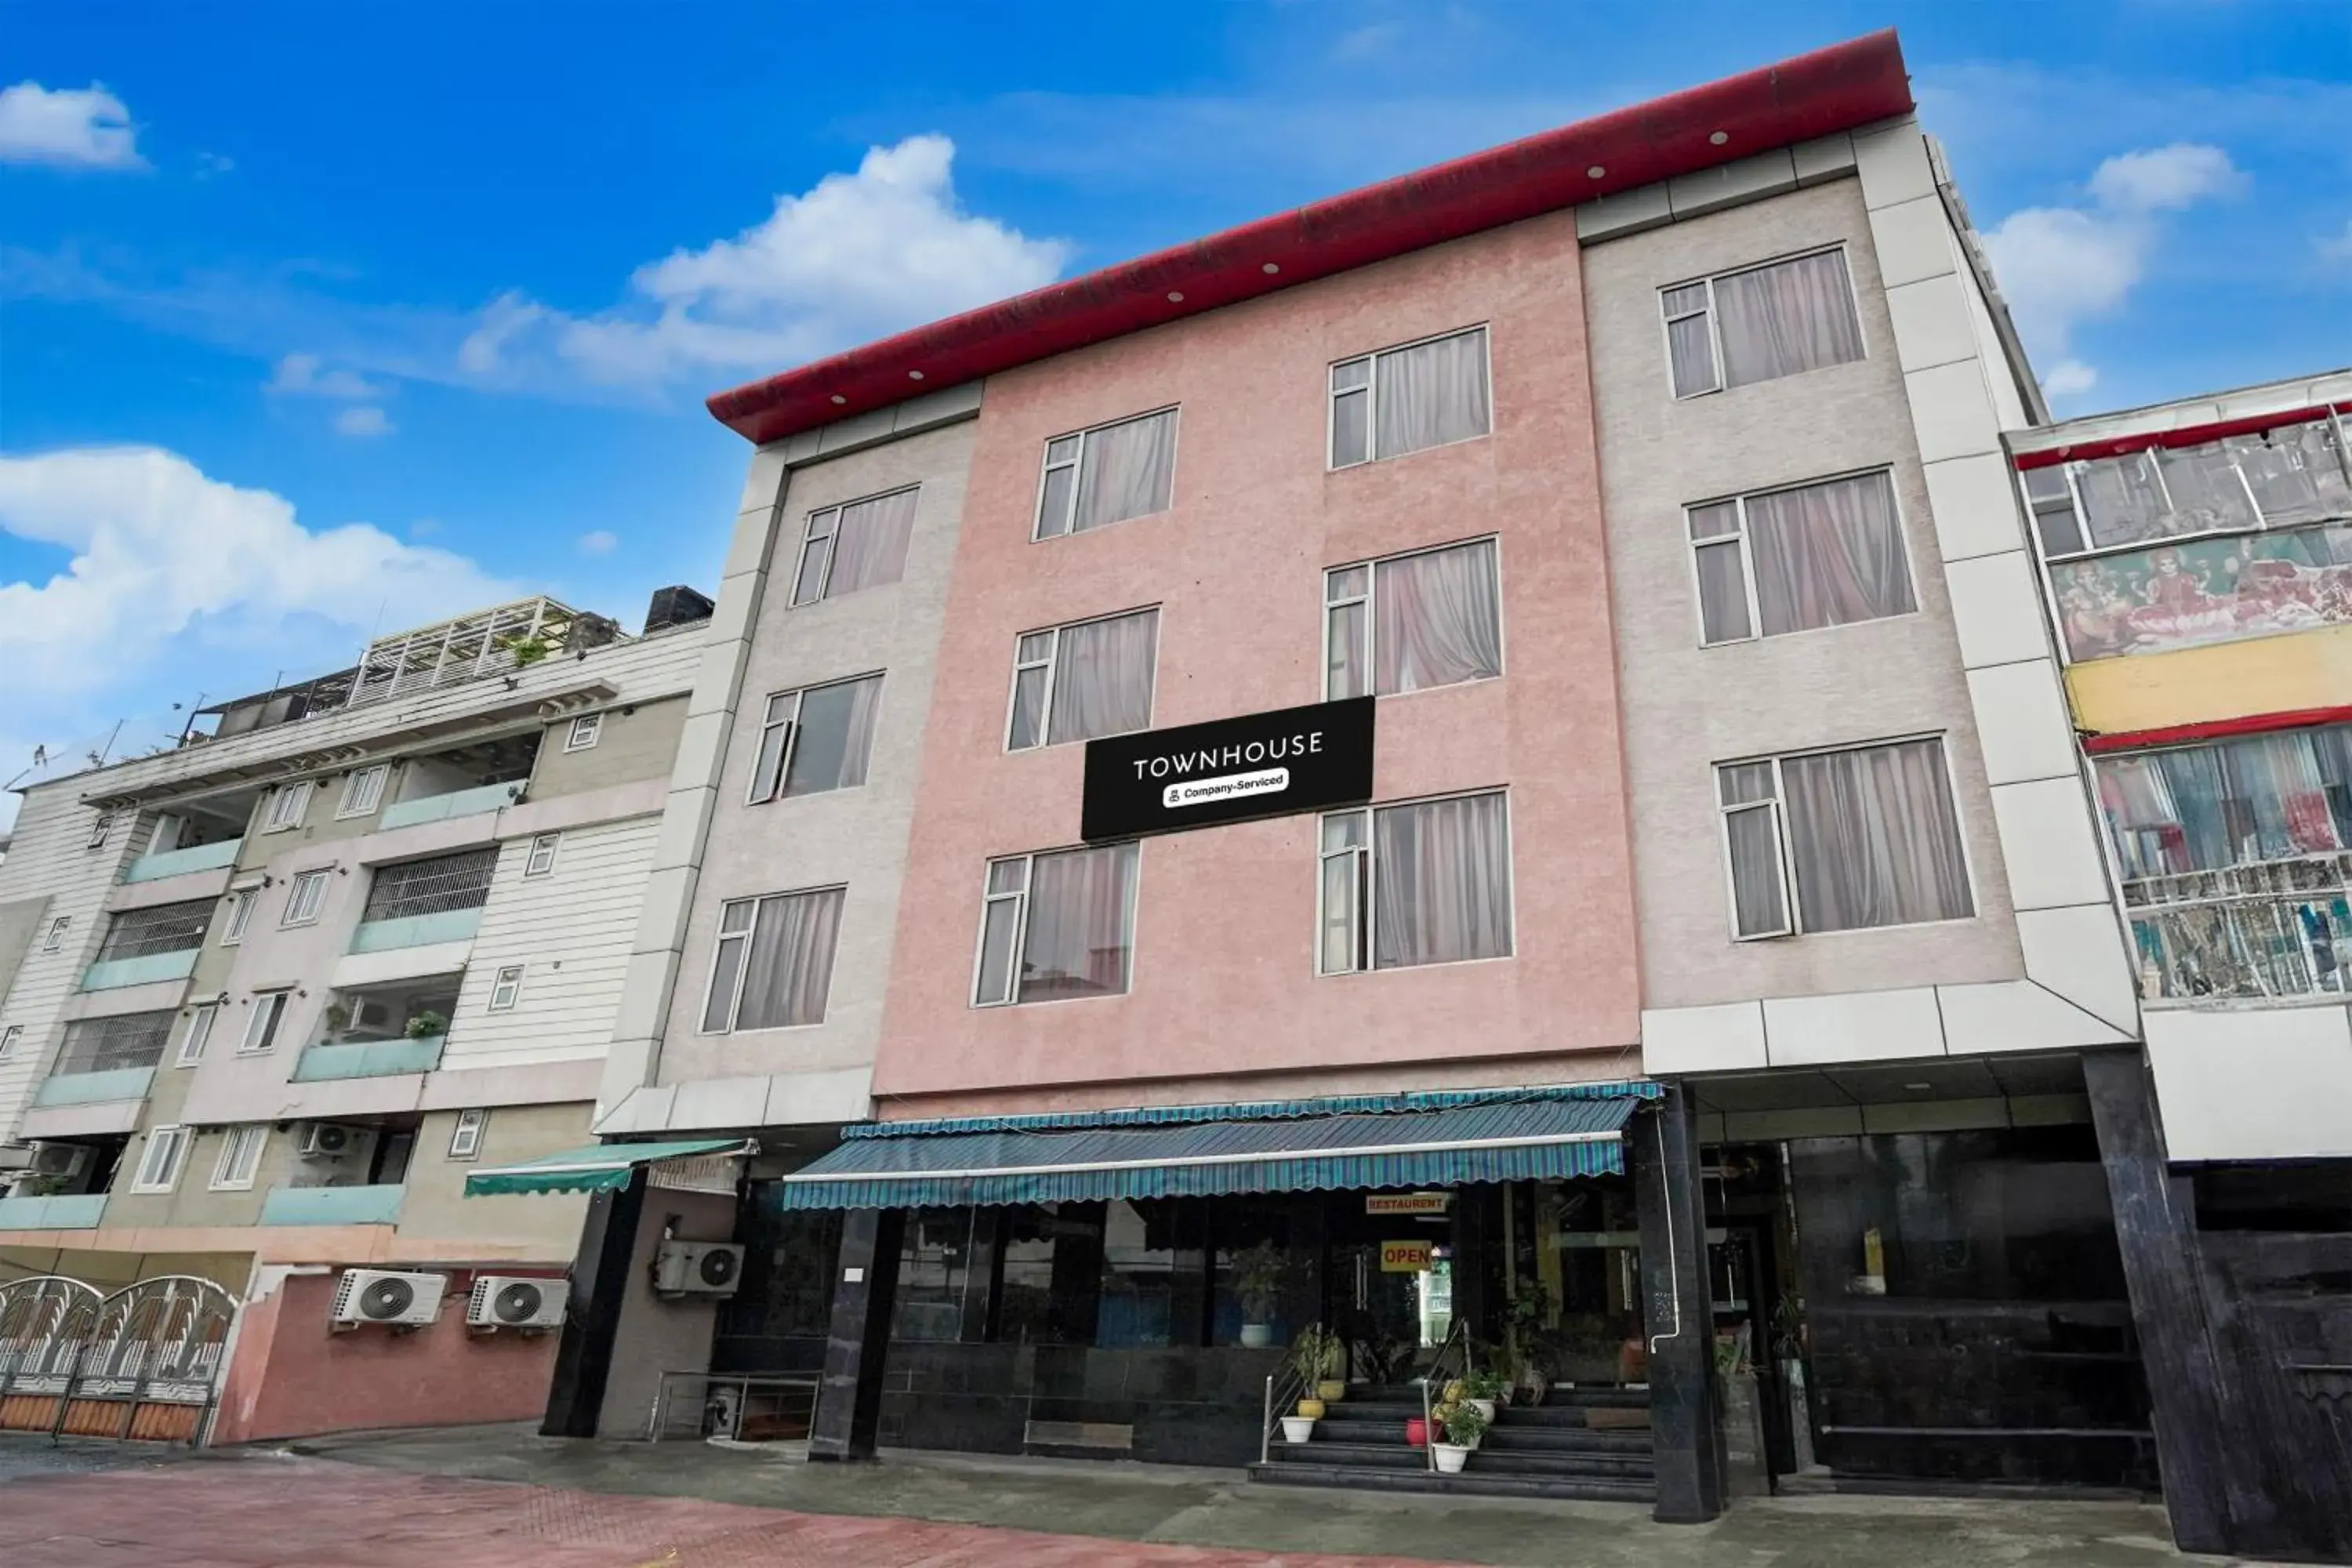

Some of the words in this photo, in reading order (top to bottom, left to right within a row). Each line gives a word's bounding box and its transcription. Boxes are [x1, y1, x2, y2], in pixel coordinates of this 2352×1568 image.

[1134, 732, 1323, 780] TOWNHOUSE
[1185, 775, 1283, 798] Company-Serviced
[1384, 1248, 1430, 1264] OPEN
